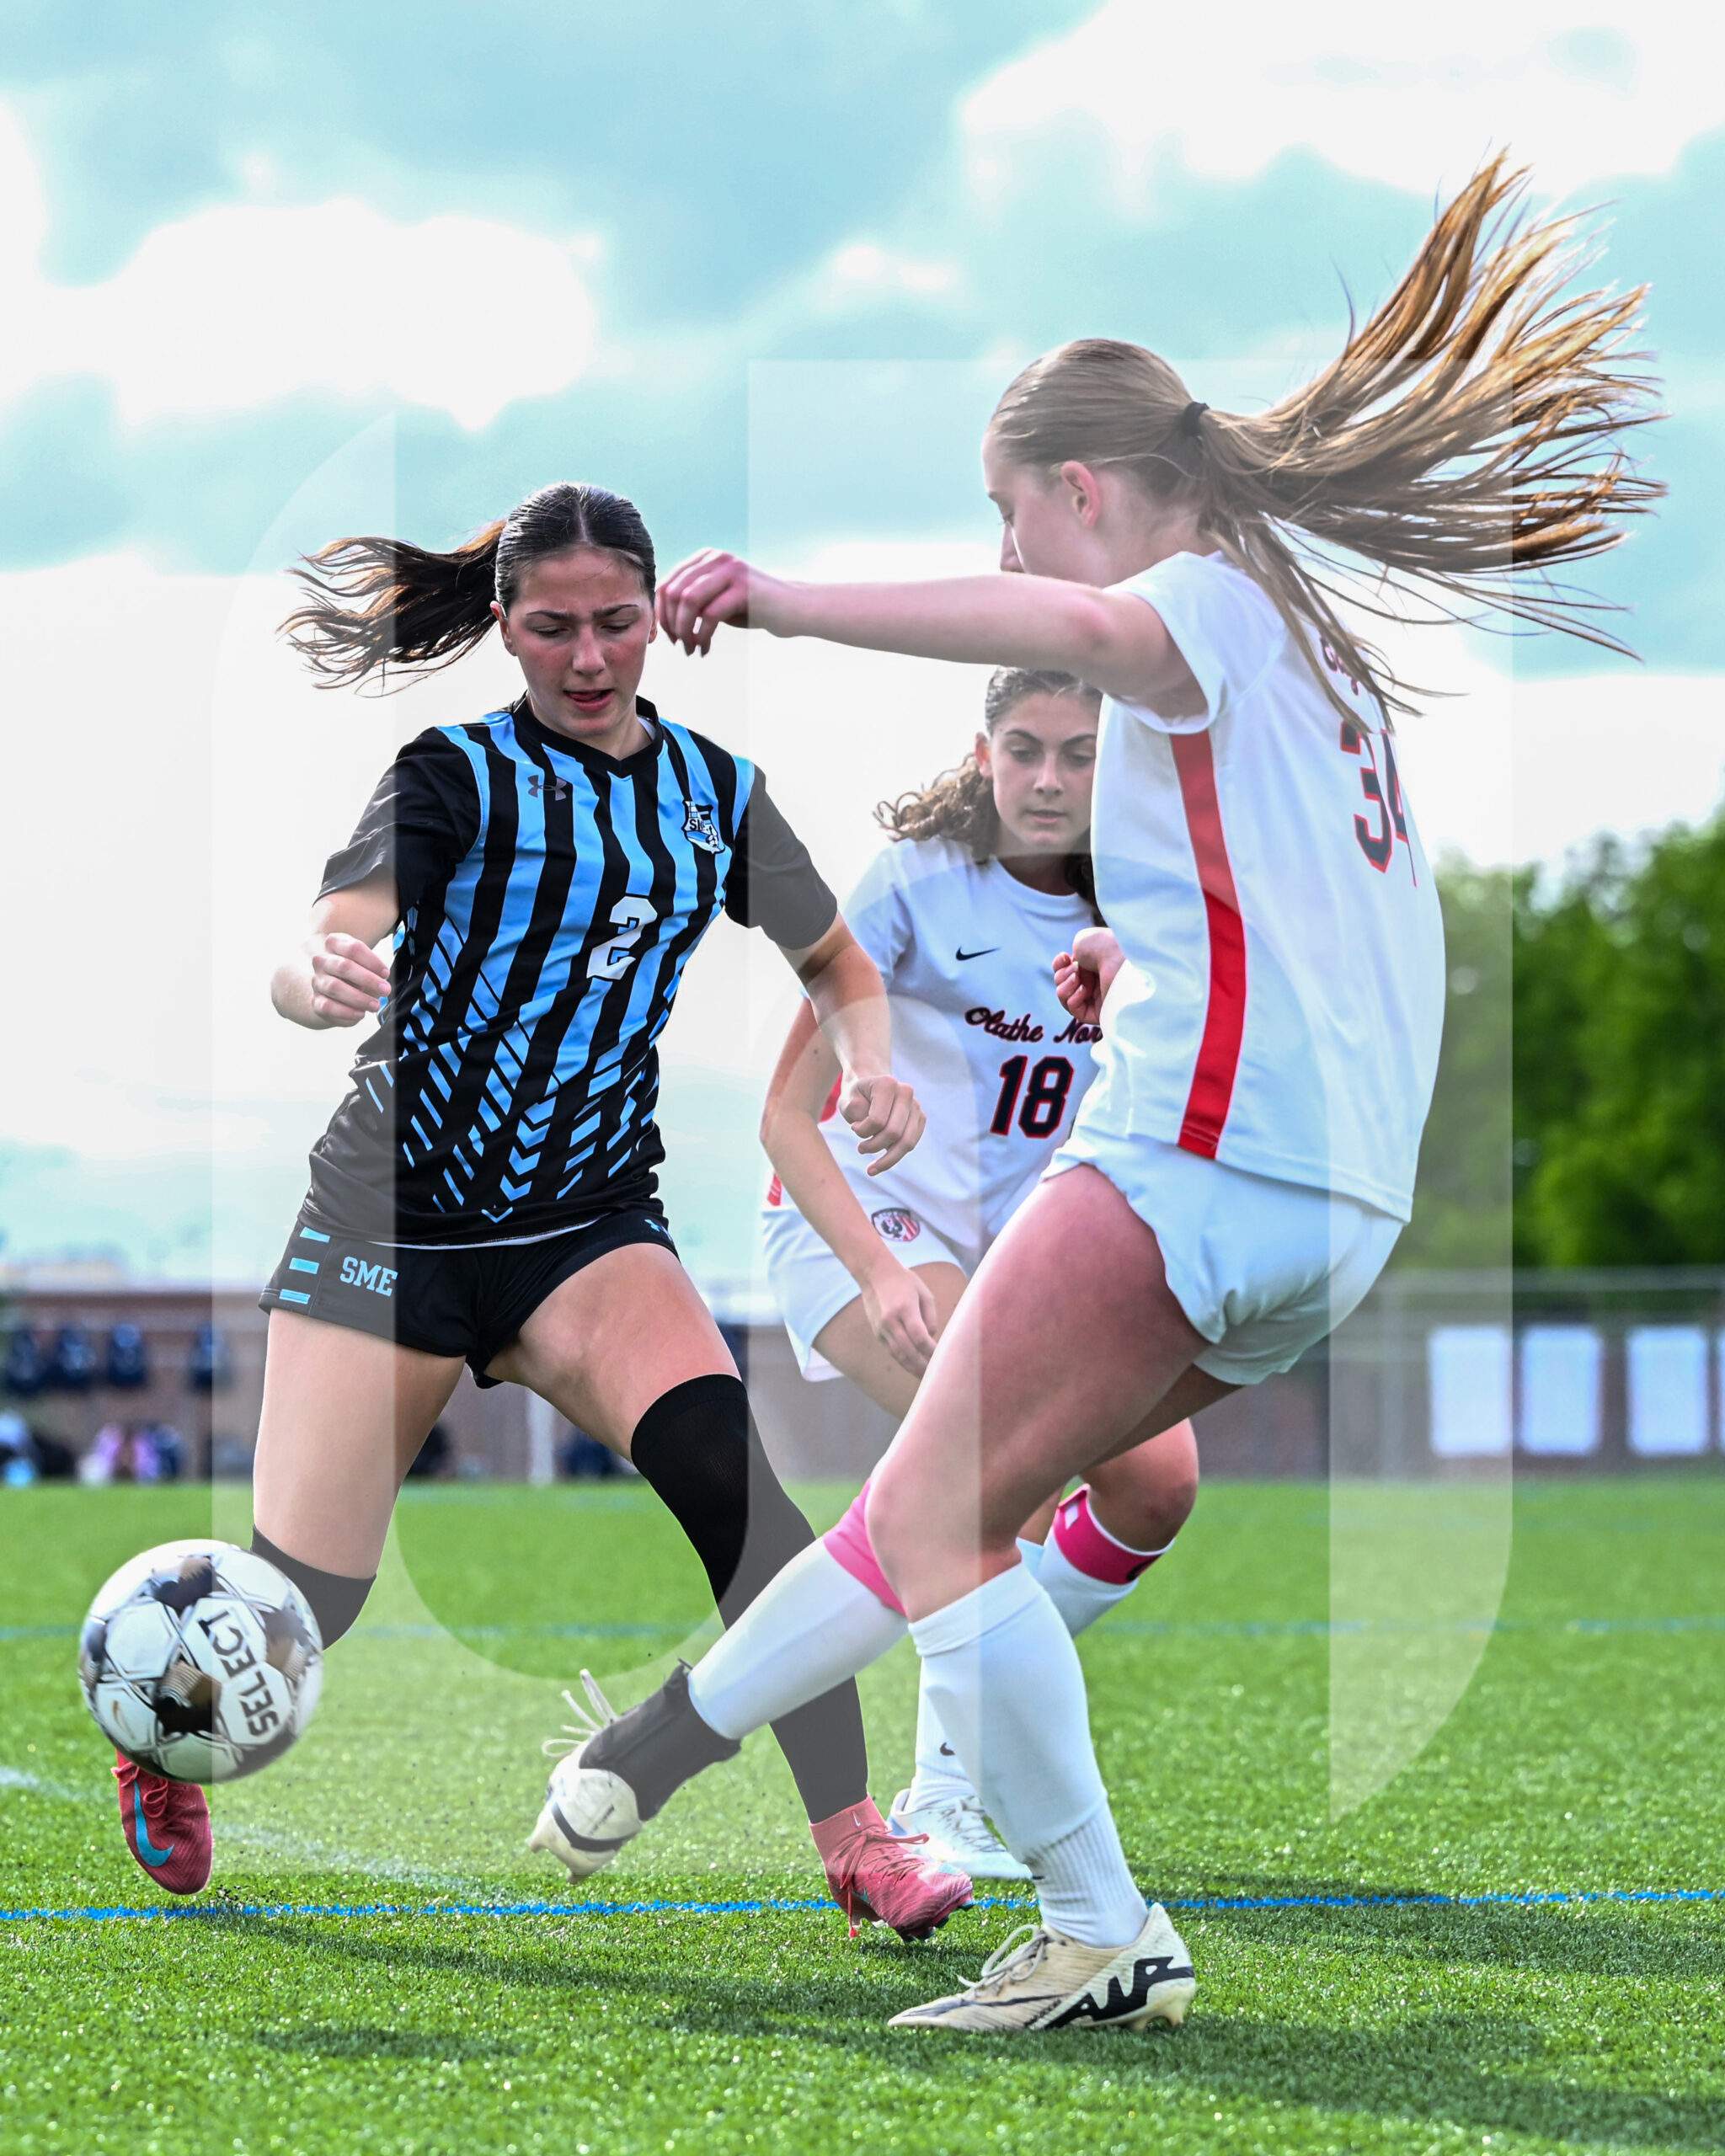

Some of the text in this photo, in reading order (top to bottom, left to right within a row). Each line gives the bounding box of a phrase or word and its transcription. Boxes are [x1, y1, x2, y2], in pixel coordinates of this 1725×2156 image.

[586, 894, 658, 980] 2
[964, 1006, 1044, 1043] Olathe
[990, 1054, 1074, 1139] 18
[339, 1256, 398, 1297] SME
[198, 1610, 280, 1737] SELECT
